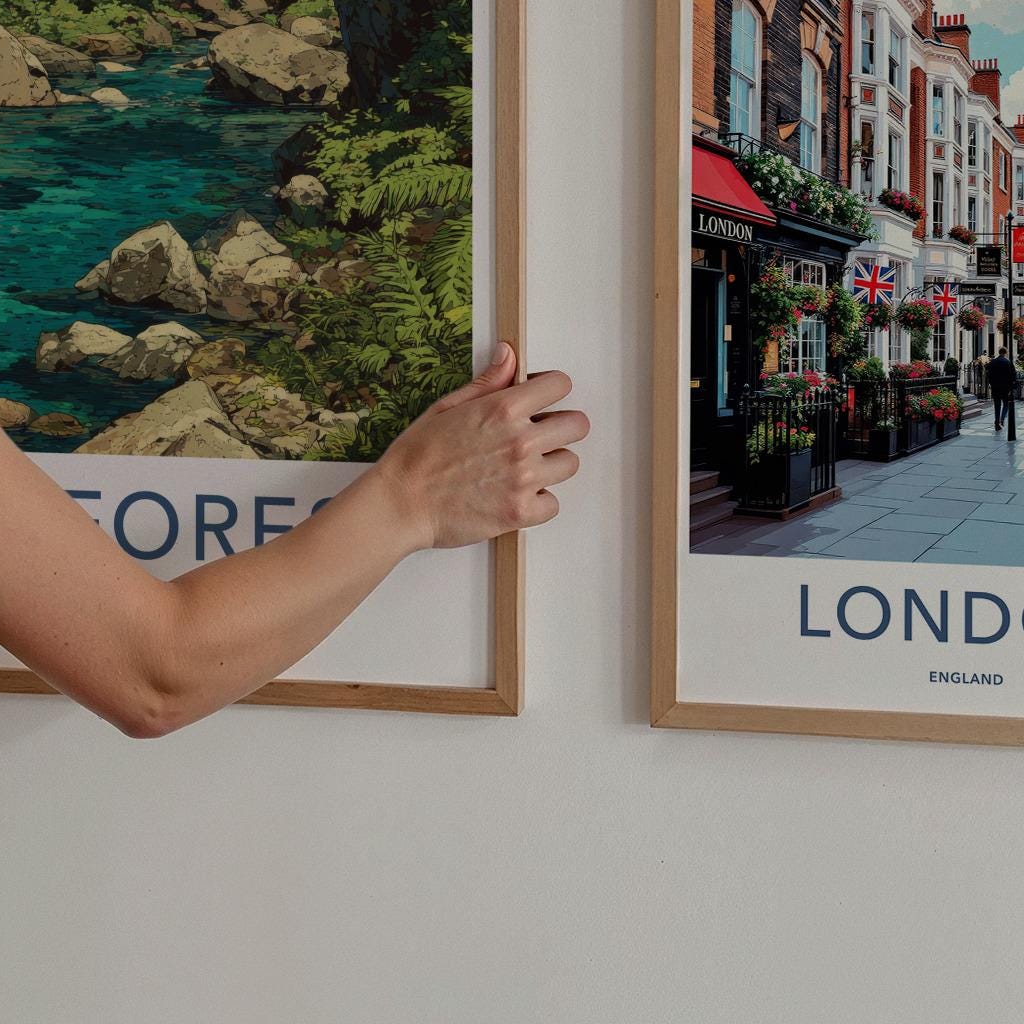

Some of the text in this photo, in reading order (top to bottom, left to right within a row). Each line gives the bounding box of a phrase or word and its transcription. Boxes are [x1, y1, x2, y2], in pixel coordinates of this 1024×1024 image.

[698, 213, 753, 242] LONDON
[800, 584, 1024, 645] LOND
[929, 670, 1004, 686] ENGLAND
